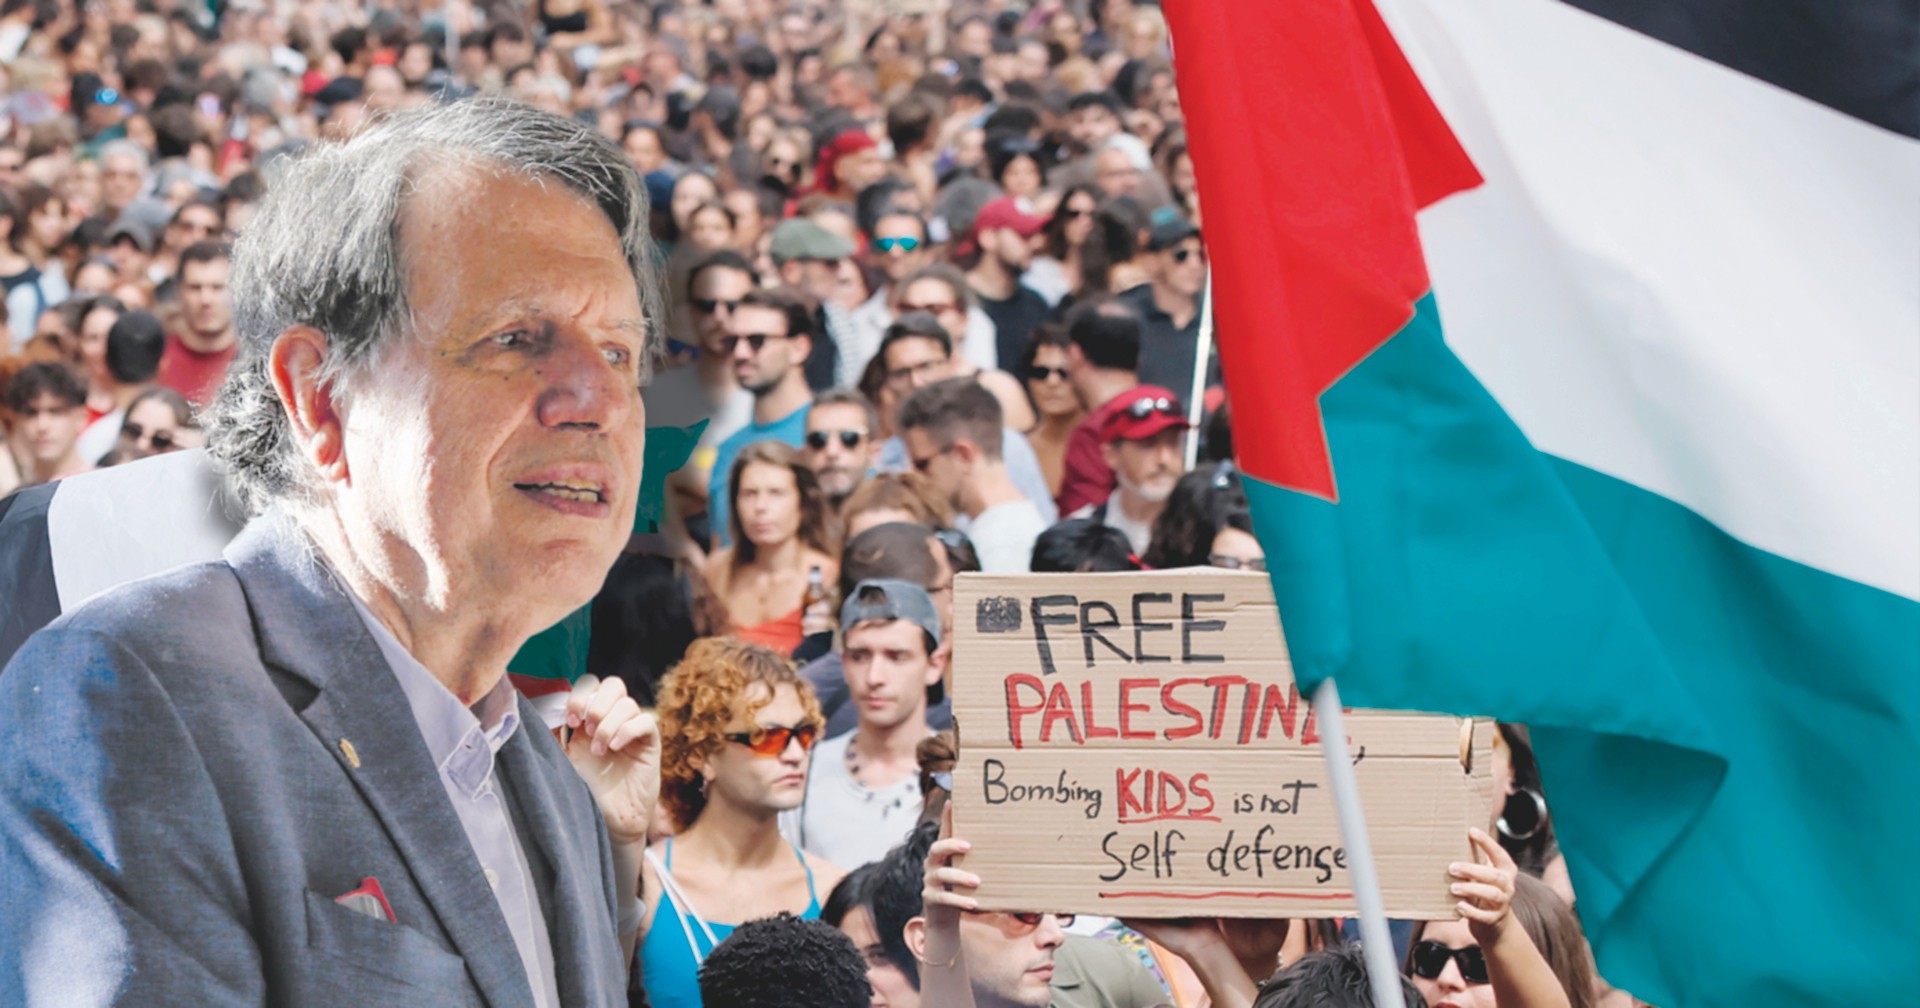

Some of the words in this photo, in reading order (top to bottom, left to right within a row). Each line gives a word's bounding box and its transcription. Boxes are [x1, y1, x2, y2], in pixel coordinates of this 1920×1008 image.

[1030, 593, 1226, 676] FREE
[983, 758, 1102, 819] Bombing
[1116, 767, 1215, 818] KIDS
[1099, 829, 1186, 882] Self
